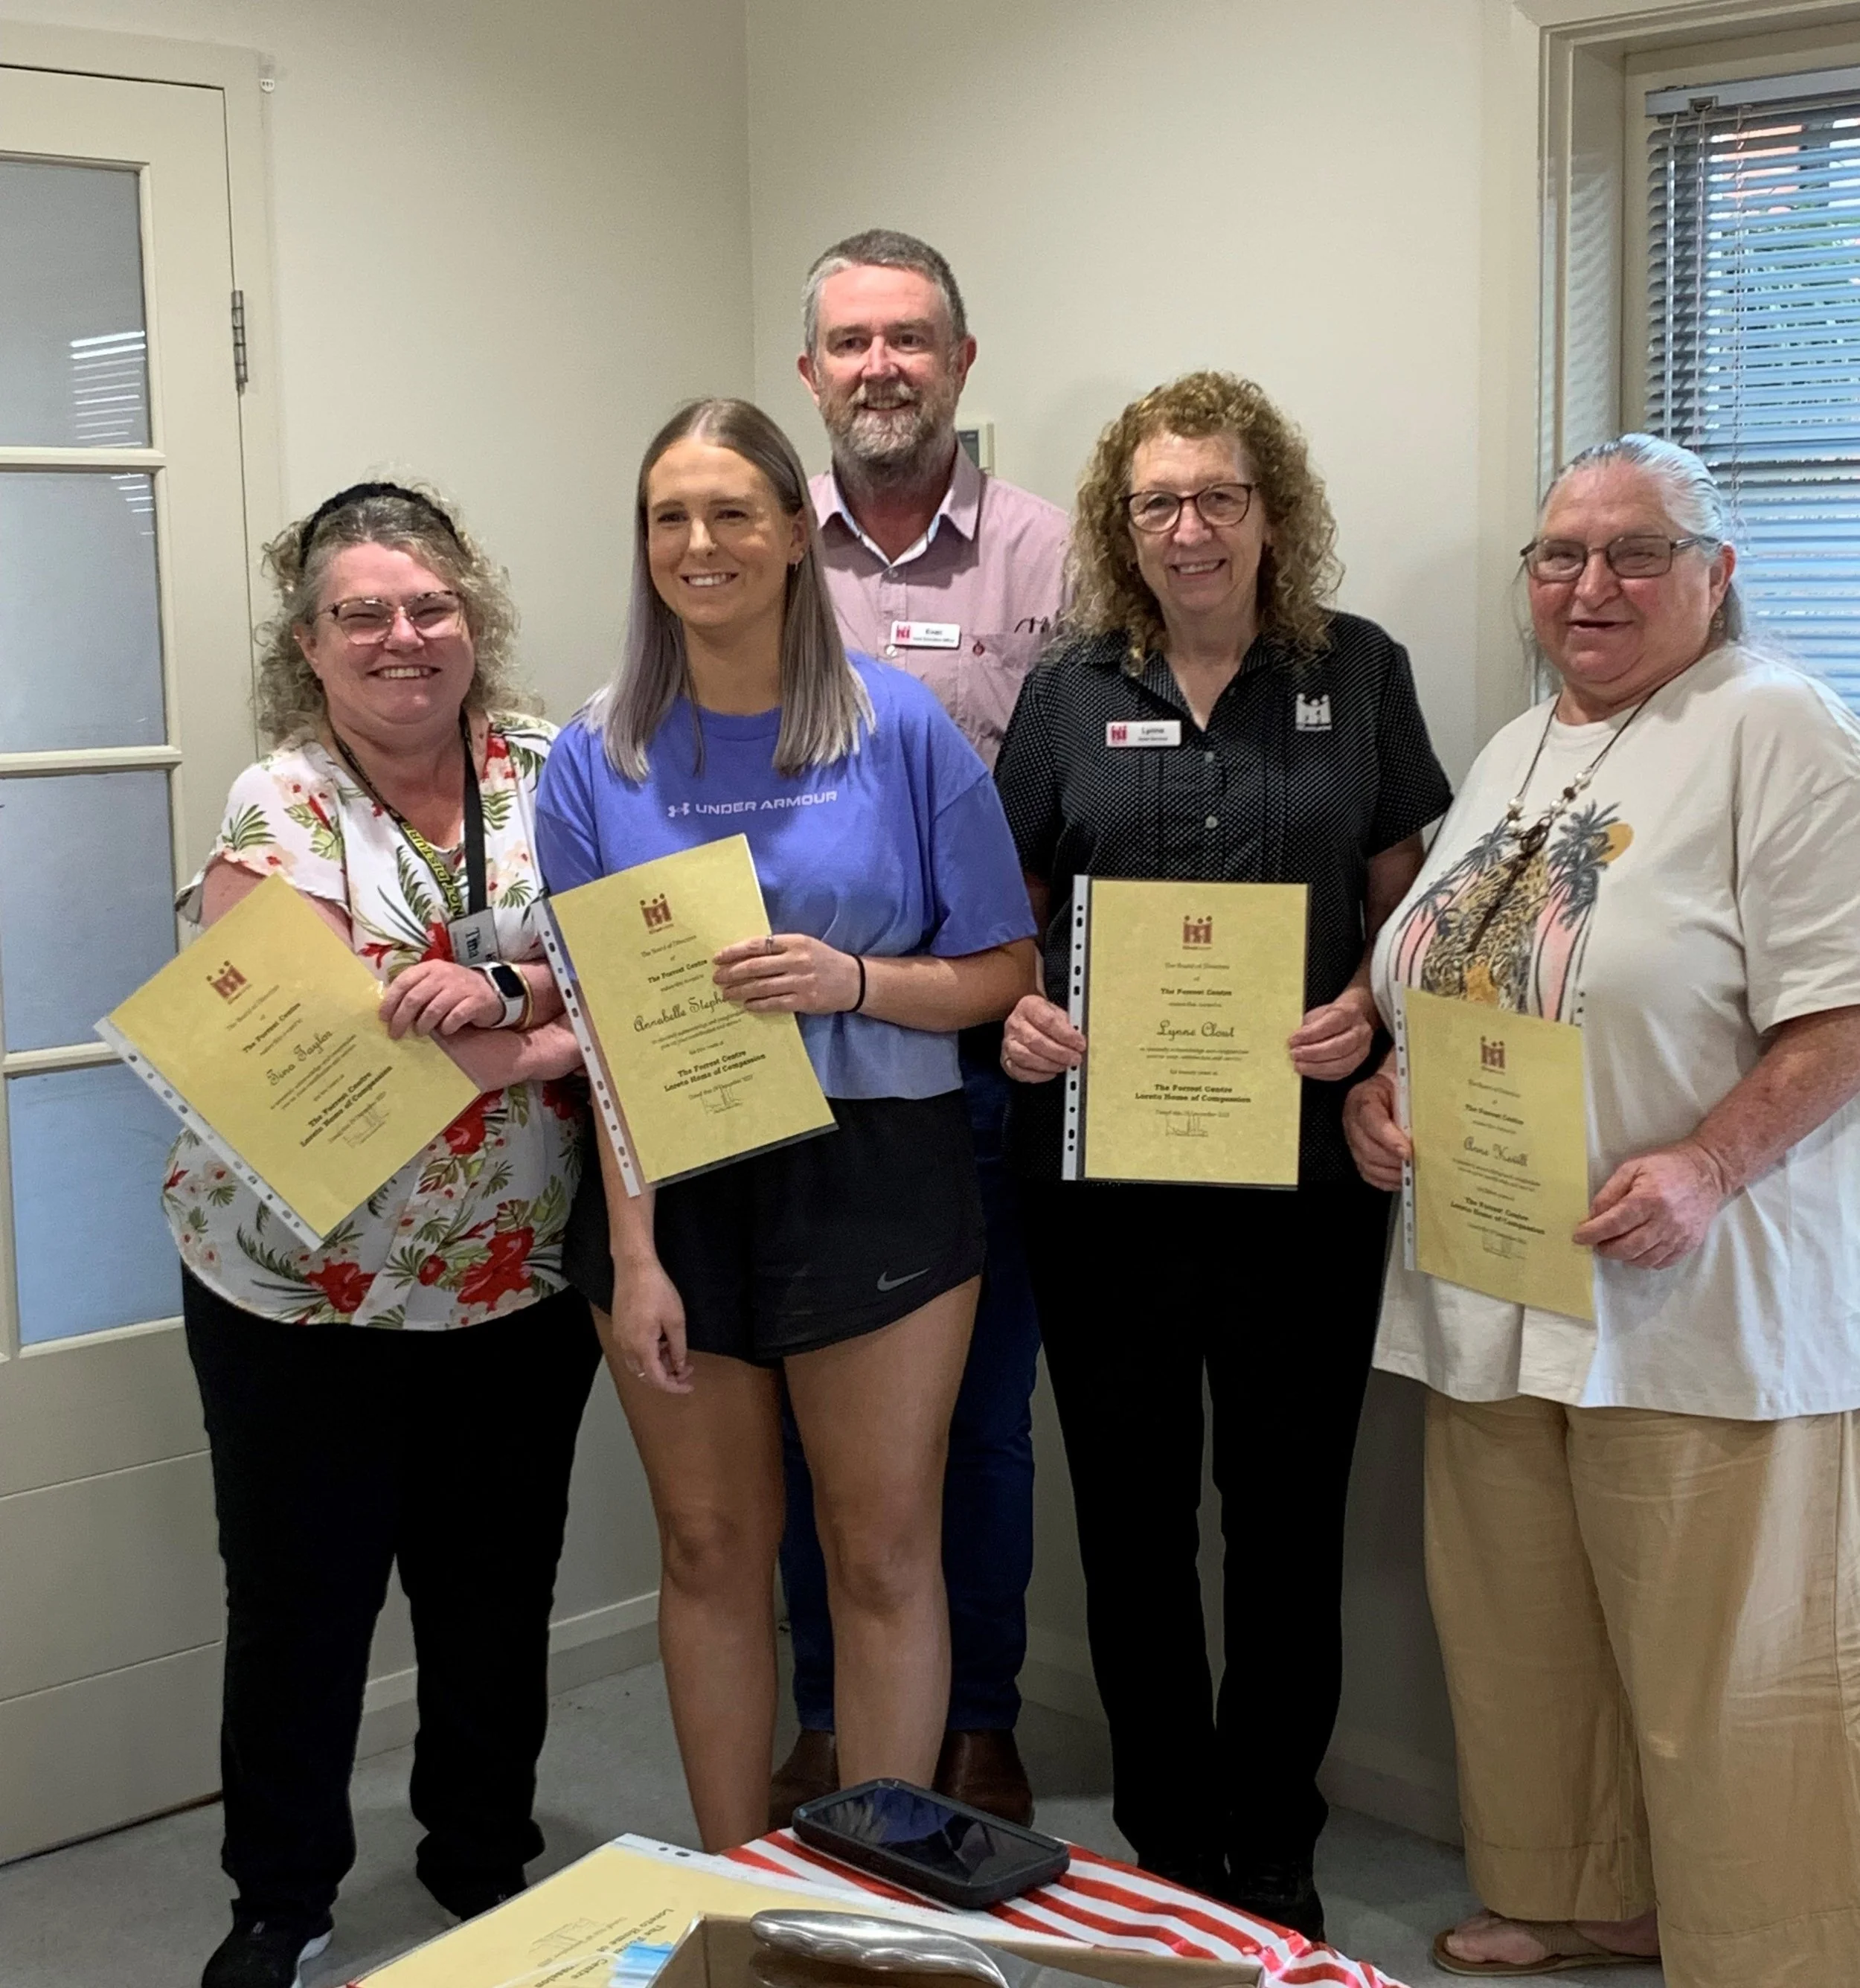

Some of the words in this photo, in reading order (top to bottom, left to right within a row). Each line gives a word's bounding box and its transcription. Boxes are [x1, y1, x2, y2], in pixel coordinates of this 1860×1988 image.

[1141, 727, 1164, 735] Lynne
[695, 801, 756, 815] UNDER
[760, 790, 838, 811] ARMOUR
[446, 884, 465, 920] NOT
[466, 927, 481, 959] Tina
[633, 1003, 687, 1032] Annabelle
[1156, 1019, 1196, 1041] Lynne
[265, 1064, 296, 1086] Tina
[291, 1031, 333, 1062] Taylor
[677, 1069, 693, 1077] The
[722, 1051, 746, 1062] Centre
[713, 1067, 722, 1075] of
[307, 1115, 323, 1127] The
[570, 1958, 608, 1980] Centre
